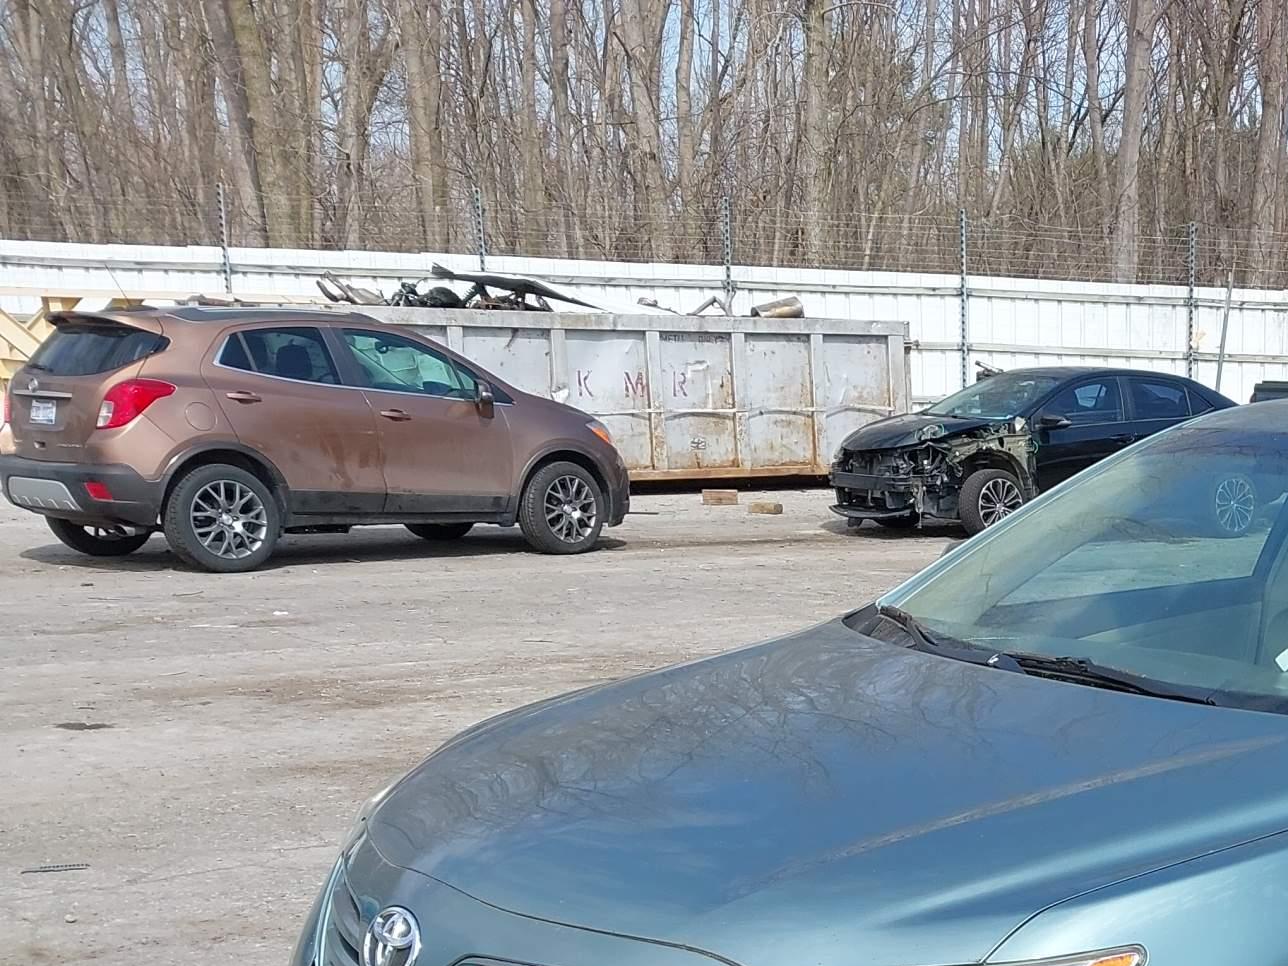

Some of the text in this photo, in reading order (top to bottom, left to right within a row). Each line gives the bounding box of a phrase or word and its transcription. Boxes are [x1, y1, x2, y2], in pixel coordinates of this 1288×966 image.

[577, 370, 689, 398] K M R
